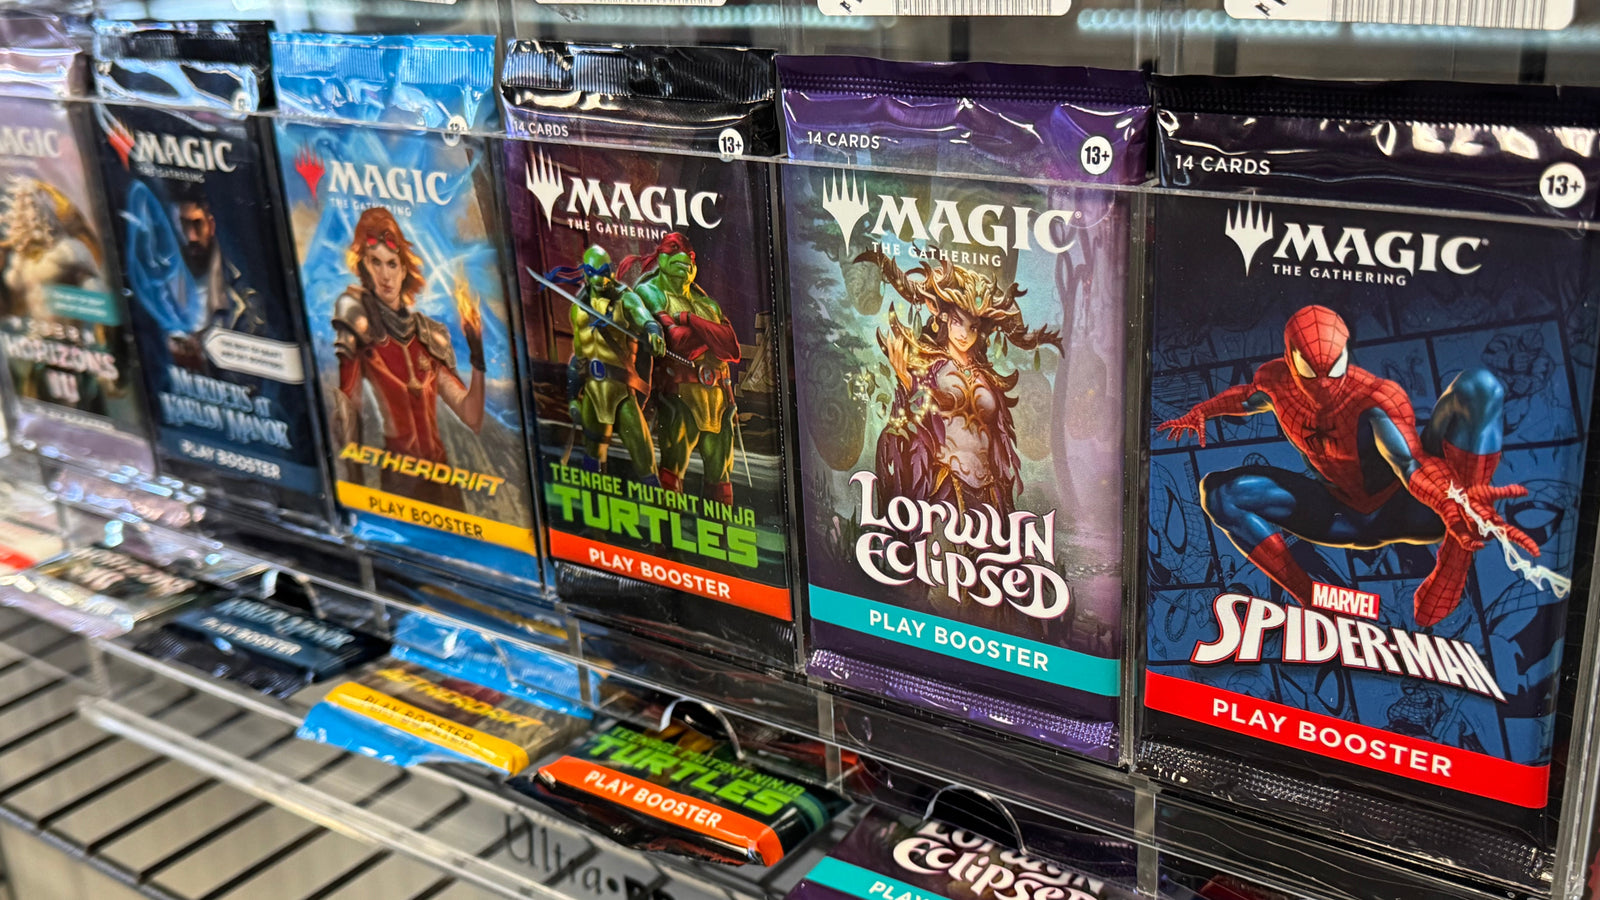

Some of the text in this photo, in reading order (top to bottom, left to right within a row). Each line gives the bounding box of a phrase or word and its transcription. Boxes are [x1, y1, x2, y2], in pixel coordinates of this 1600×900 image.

[0, 126, 61, 158] AGIC
[513, 120, 569, 137] 14 CARDS
[721, 136, 742, 154] 13+
[807, 131, 881, 149] 14 CARDS
[134, 129, 237, 173] MAGIC
[1085, 145, 1110, 166] 13+
[1175, 154, 1271, 175] 14 CARDS
[328, 160, 451, 205] MAGIC
[566, 176, 723, 231] MAGIC
[1544, 174, 1582, 197] 13+
[567, 218, 590, 232] THE
[870, 194, 1076, 257] MAGIC
[872, 241, 1002, 267] THE GATHERING
[1272, 222, 1483, 277] MAGIC
[1273, 263, 1407, 286] THE GATHERING
[339, 441, 505, 496] AETHERDRIFT
[549, 462, 756, 528] TEENAGE MUTANT NINJA
[368, 496, 484, 540] PLAY BOOSTER
[552, 483, 759, 568] TURTLES
[588, 547, 731, 599] PLAY BOOSTER
[1312, 583, 1379, 619] MARVEL
[869, 609, 1049, 672] PLAY BOOSTER
[1190, 592, 1508, 703] SPIDER-MAN
[1212, 697, 1453, 777] PLAY BOOSTER
[588, 734, 798, 816] TURTLES
[751, 773, 806, 798] NINJA
[584, 770, 723, 828] PLAY BOOSTER
[869, 880, 929, 900] PLA
